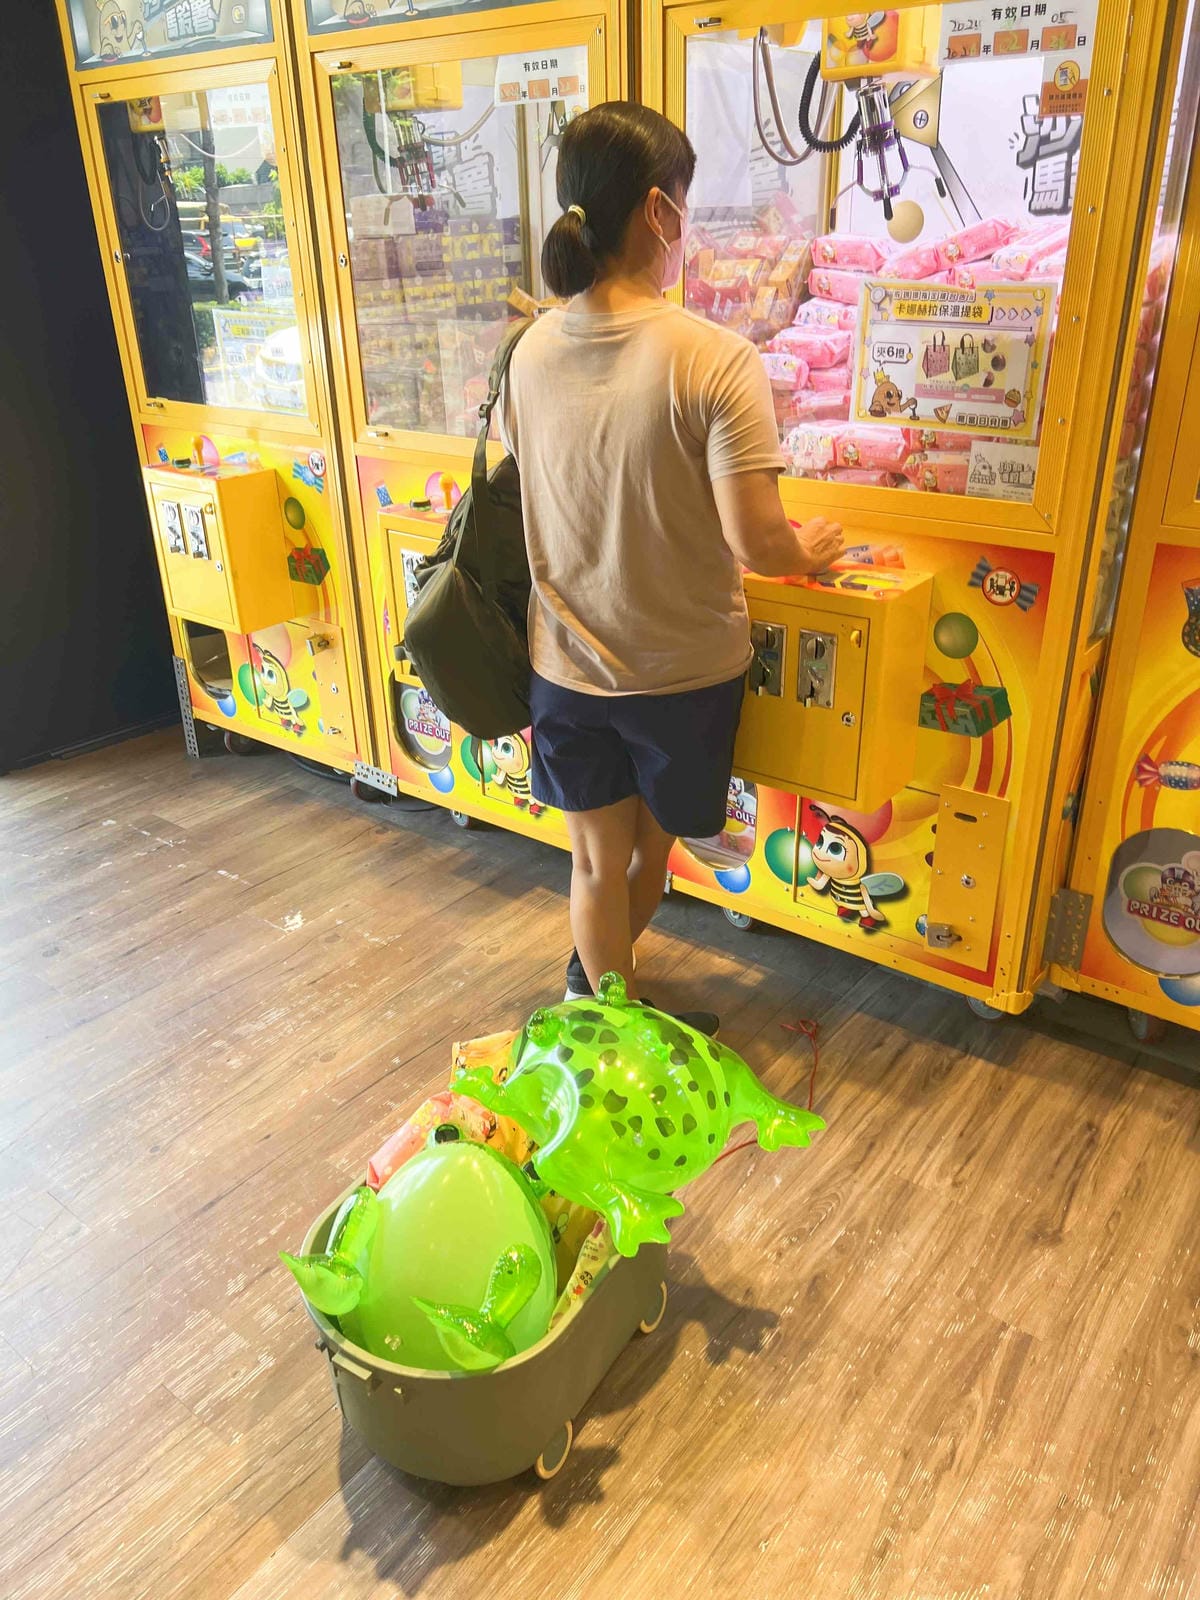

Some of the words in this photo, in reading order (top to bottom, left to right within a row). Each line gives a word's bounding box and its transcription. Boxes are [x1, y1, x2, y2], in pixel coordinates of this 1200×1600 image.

[991, 3, 1047, 21] 有效日期
[982, 44, 992, 55] 年
[1030, 39, 1040, 51] 月
[1077, 35, 1087, 47] 日
[523, 58, 559, 73] 有效日期
[551, 87, 558, 96] 月
[895, 302, 983, 318] 卡娜赫拉保溫提袋
[408, 719, 433, 735] PRIZE
[435, 728, 450, 740] OUT
[735, 811, 756, 825] OUT
[1130, 900, 1180, 925] PRIZE
